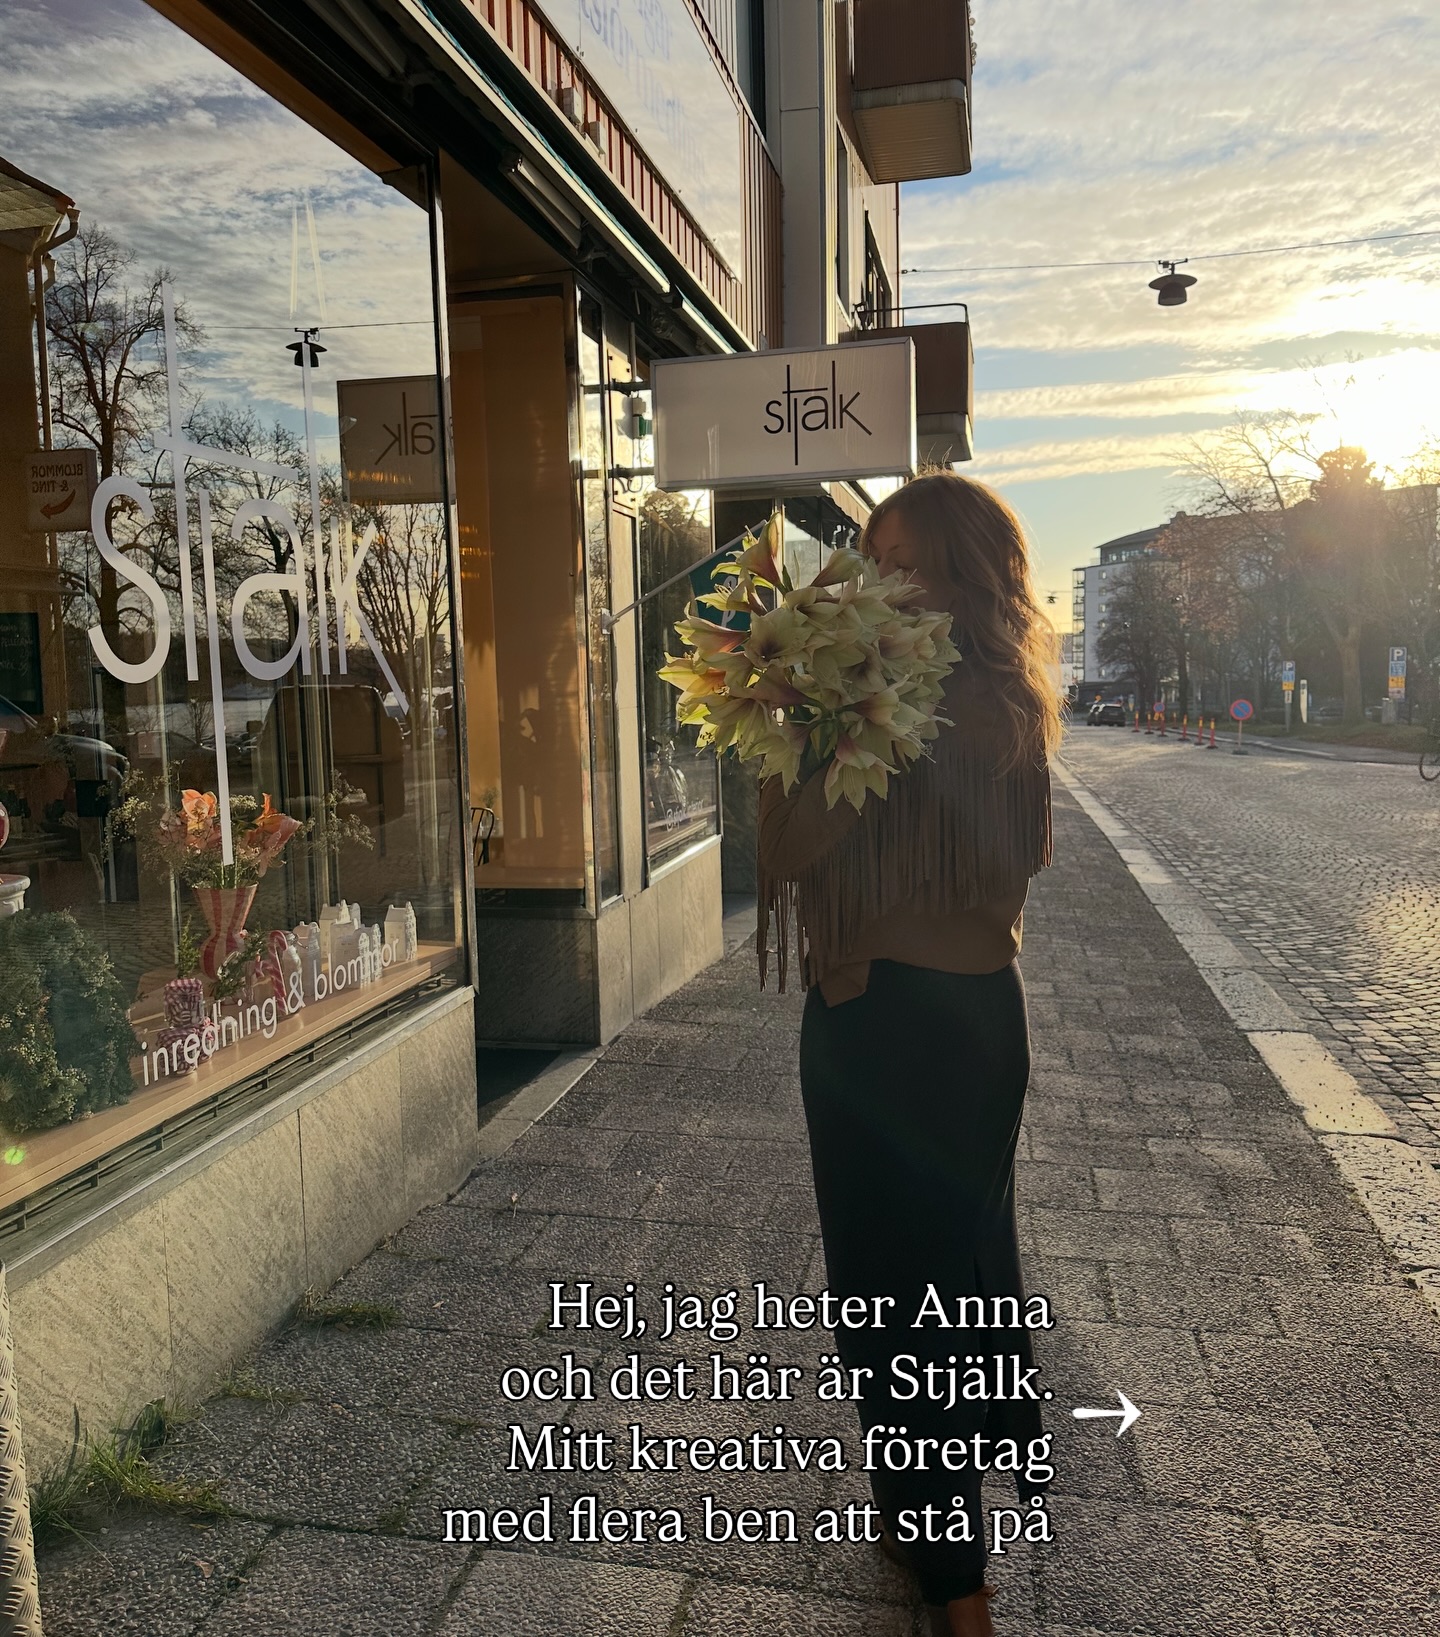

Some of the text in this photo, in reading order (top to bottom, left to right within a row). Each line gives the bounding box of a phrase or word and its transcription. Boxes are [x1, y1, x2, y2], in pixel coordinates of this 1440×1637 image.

[1393, 648, 1404, 661] P
[1285, 661, 1294, 671] P
[141, 938, 400, 1087] inredning & blommor
